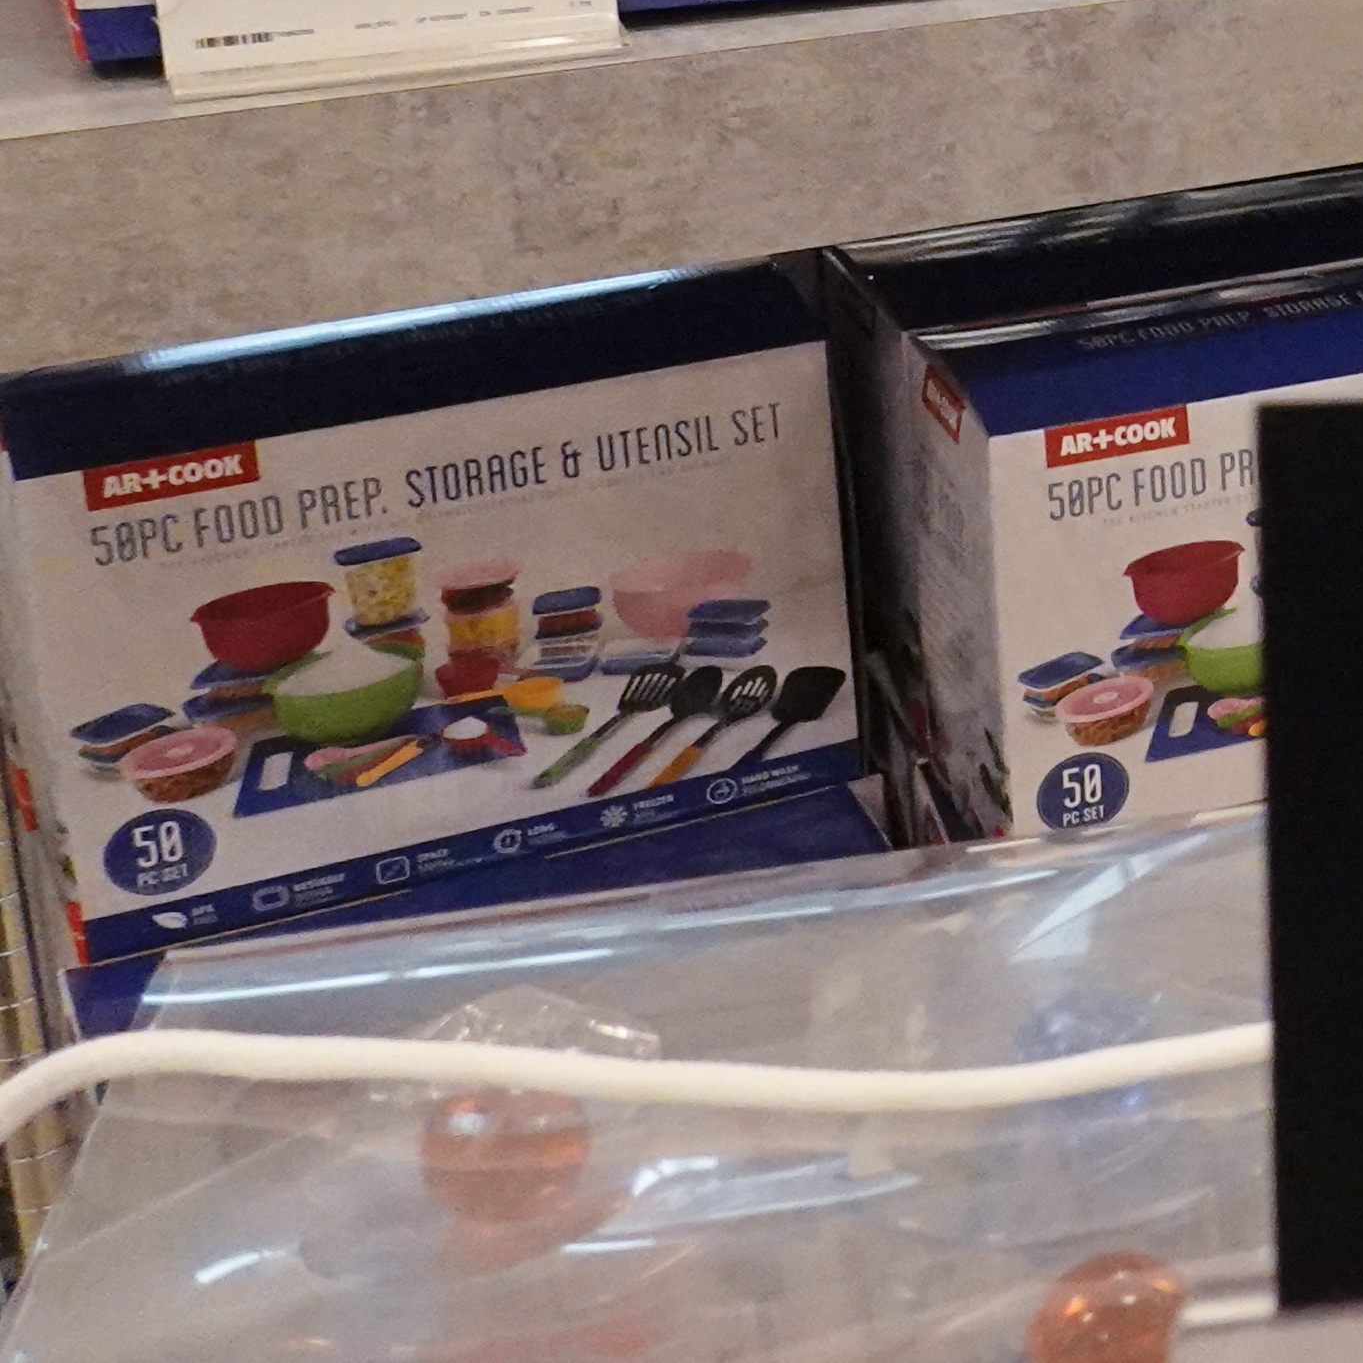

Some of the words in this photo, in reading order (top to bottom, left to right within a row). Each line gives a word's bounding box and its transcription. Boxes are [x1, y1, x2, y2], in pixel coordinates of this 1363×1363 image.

[1060, 417, 1177, 456] AR+COOK
[91, 514, 183, 566] 50PC
[194, 495, 284, 548] FOOD
[405, 446, 547, 508] STORAGE
[562, 441, 581, 478] &
[597, 415, 720, 472] UTENSIL
[732, 403, 781, 448] SET
[103, 454, 244, 498] AR+COOK
[1048, 473, 1122, 521] 50PC
[1133, 458, 1207, 506] FOOD
[1062, 763, 1102, 809] 50
[1062, 811, 1081, 827] PC
[1081, 805, 1106, 823] SET
[133, 821, 184, 868] 50
